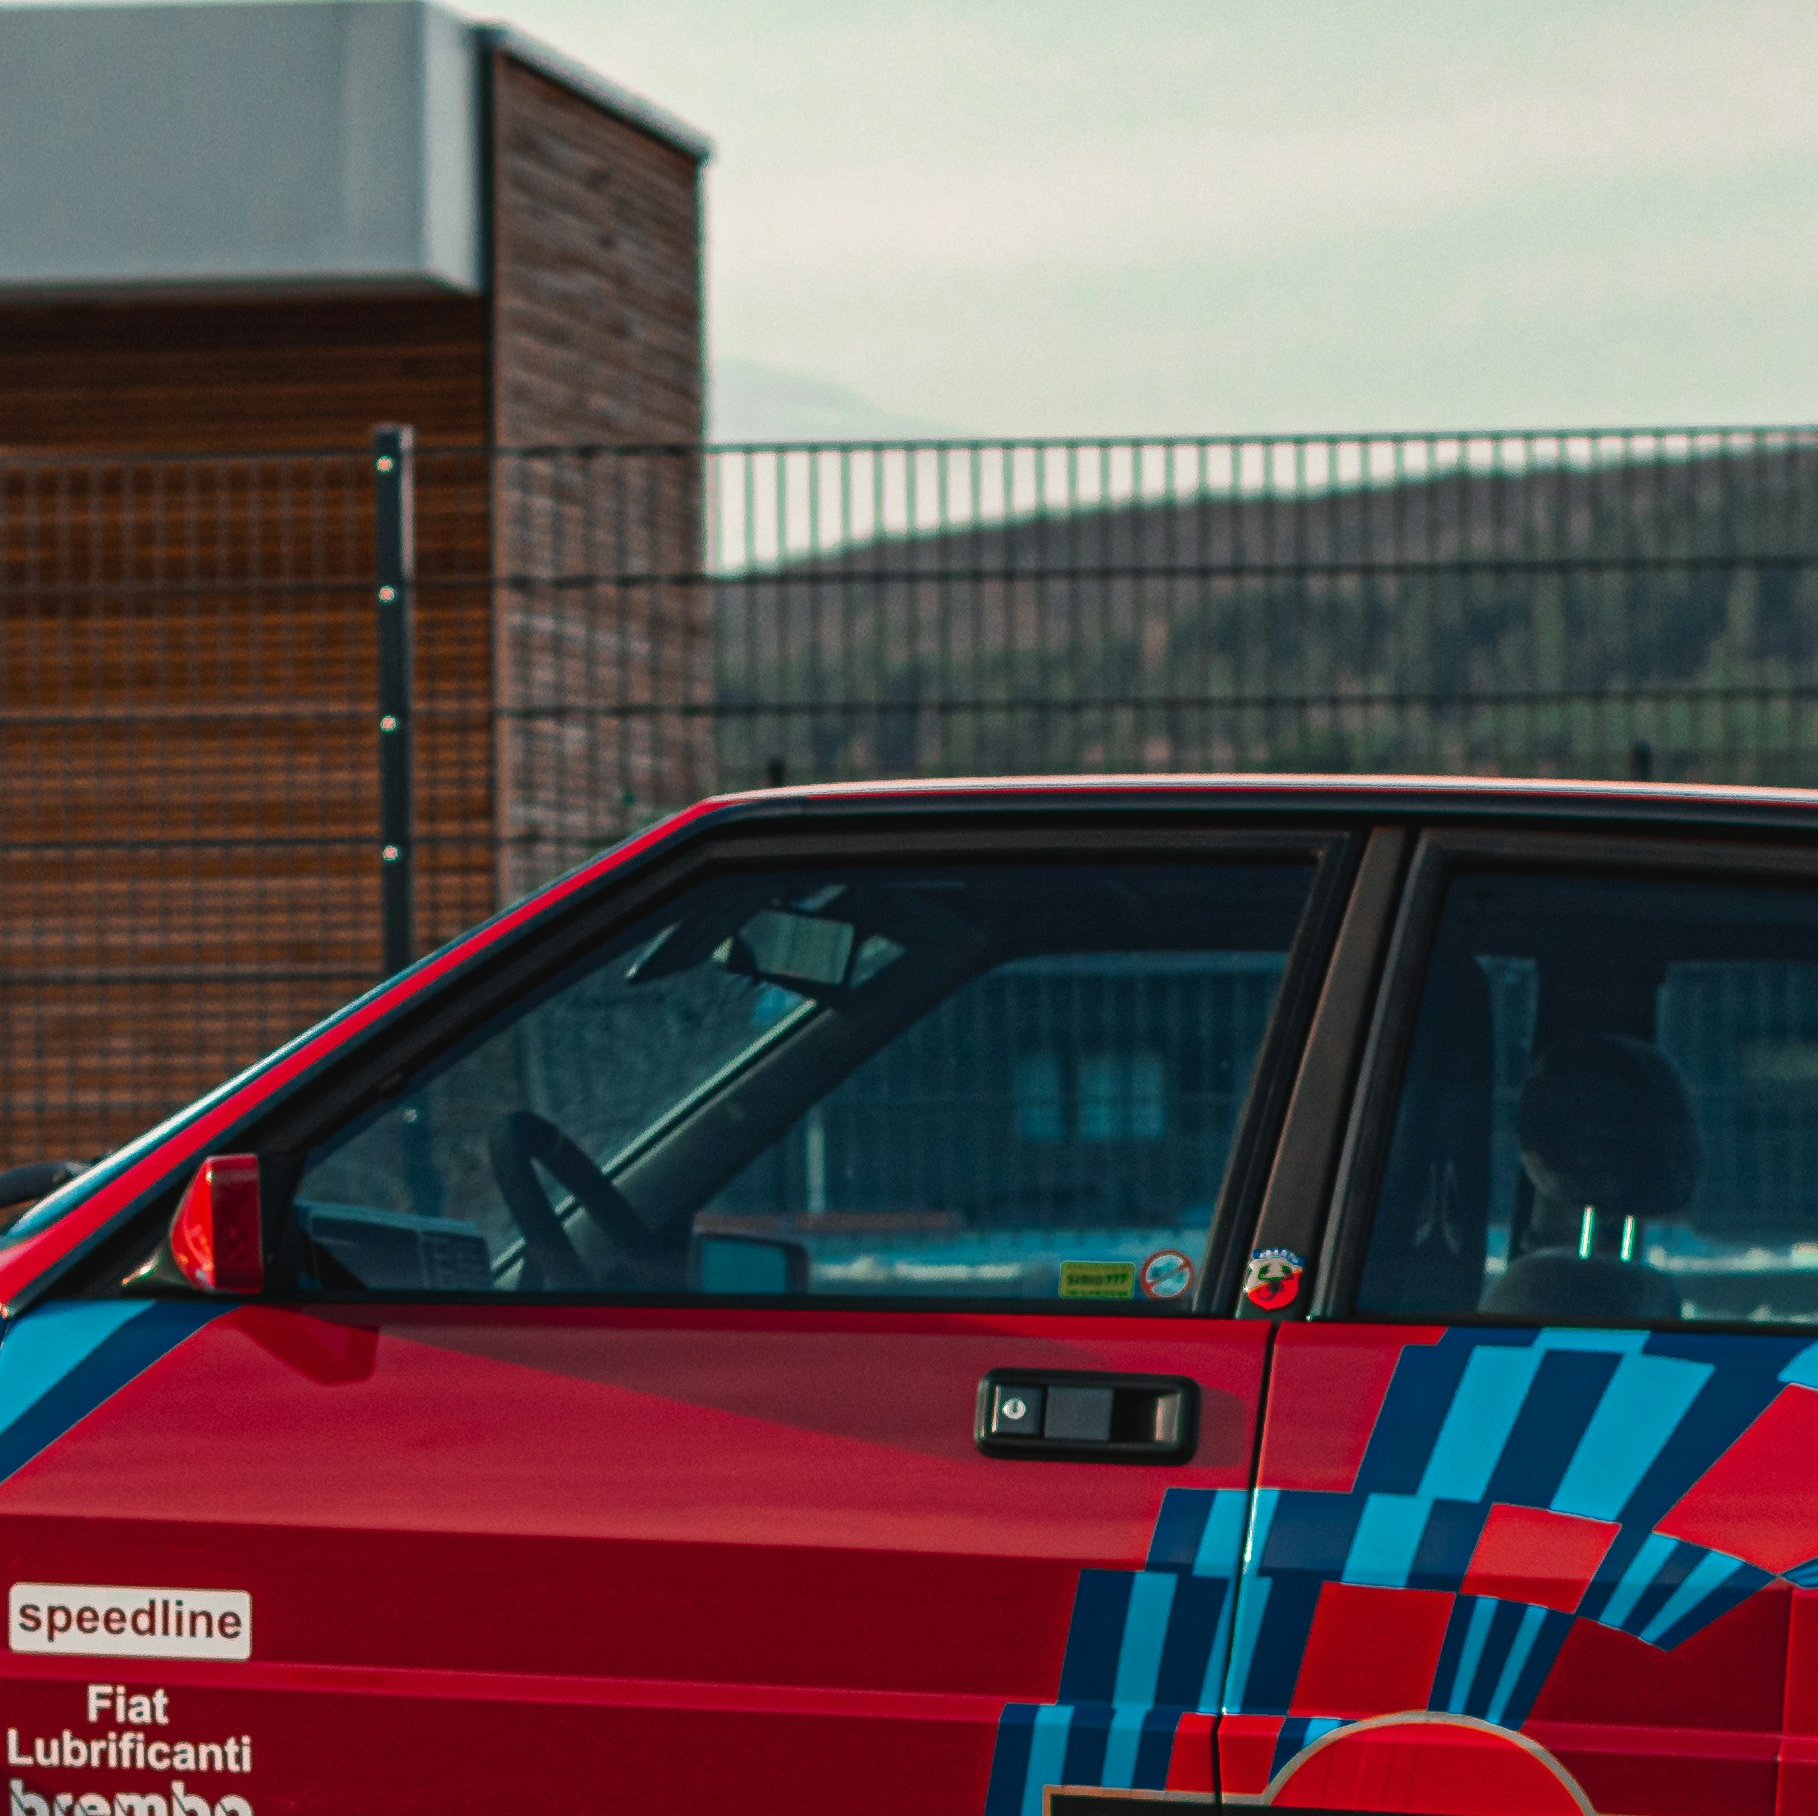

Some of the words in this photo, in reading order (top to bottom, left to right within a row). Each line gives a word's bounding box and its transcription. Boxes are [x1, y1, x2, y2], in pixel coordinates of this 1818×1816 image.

[19, 1599, 242, 1642] speedline
[87, 1684, 169, 1725] Fiat
[7, 1728, 252, 1773] Lubrificanti
